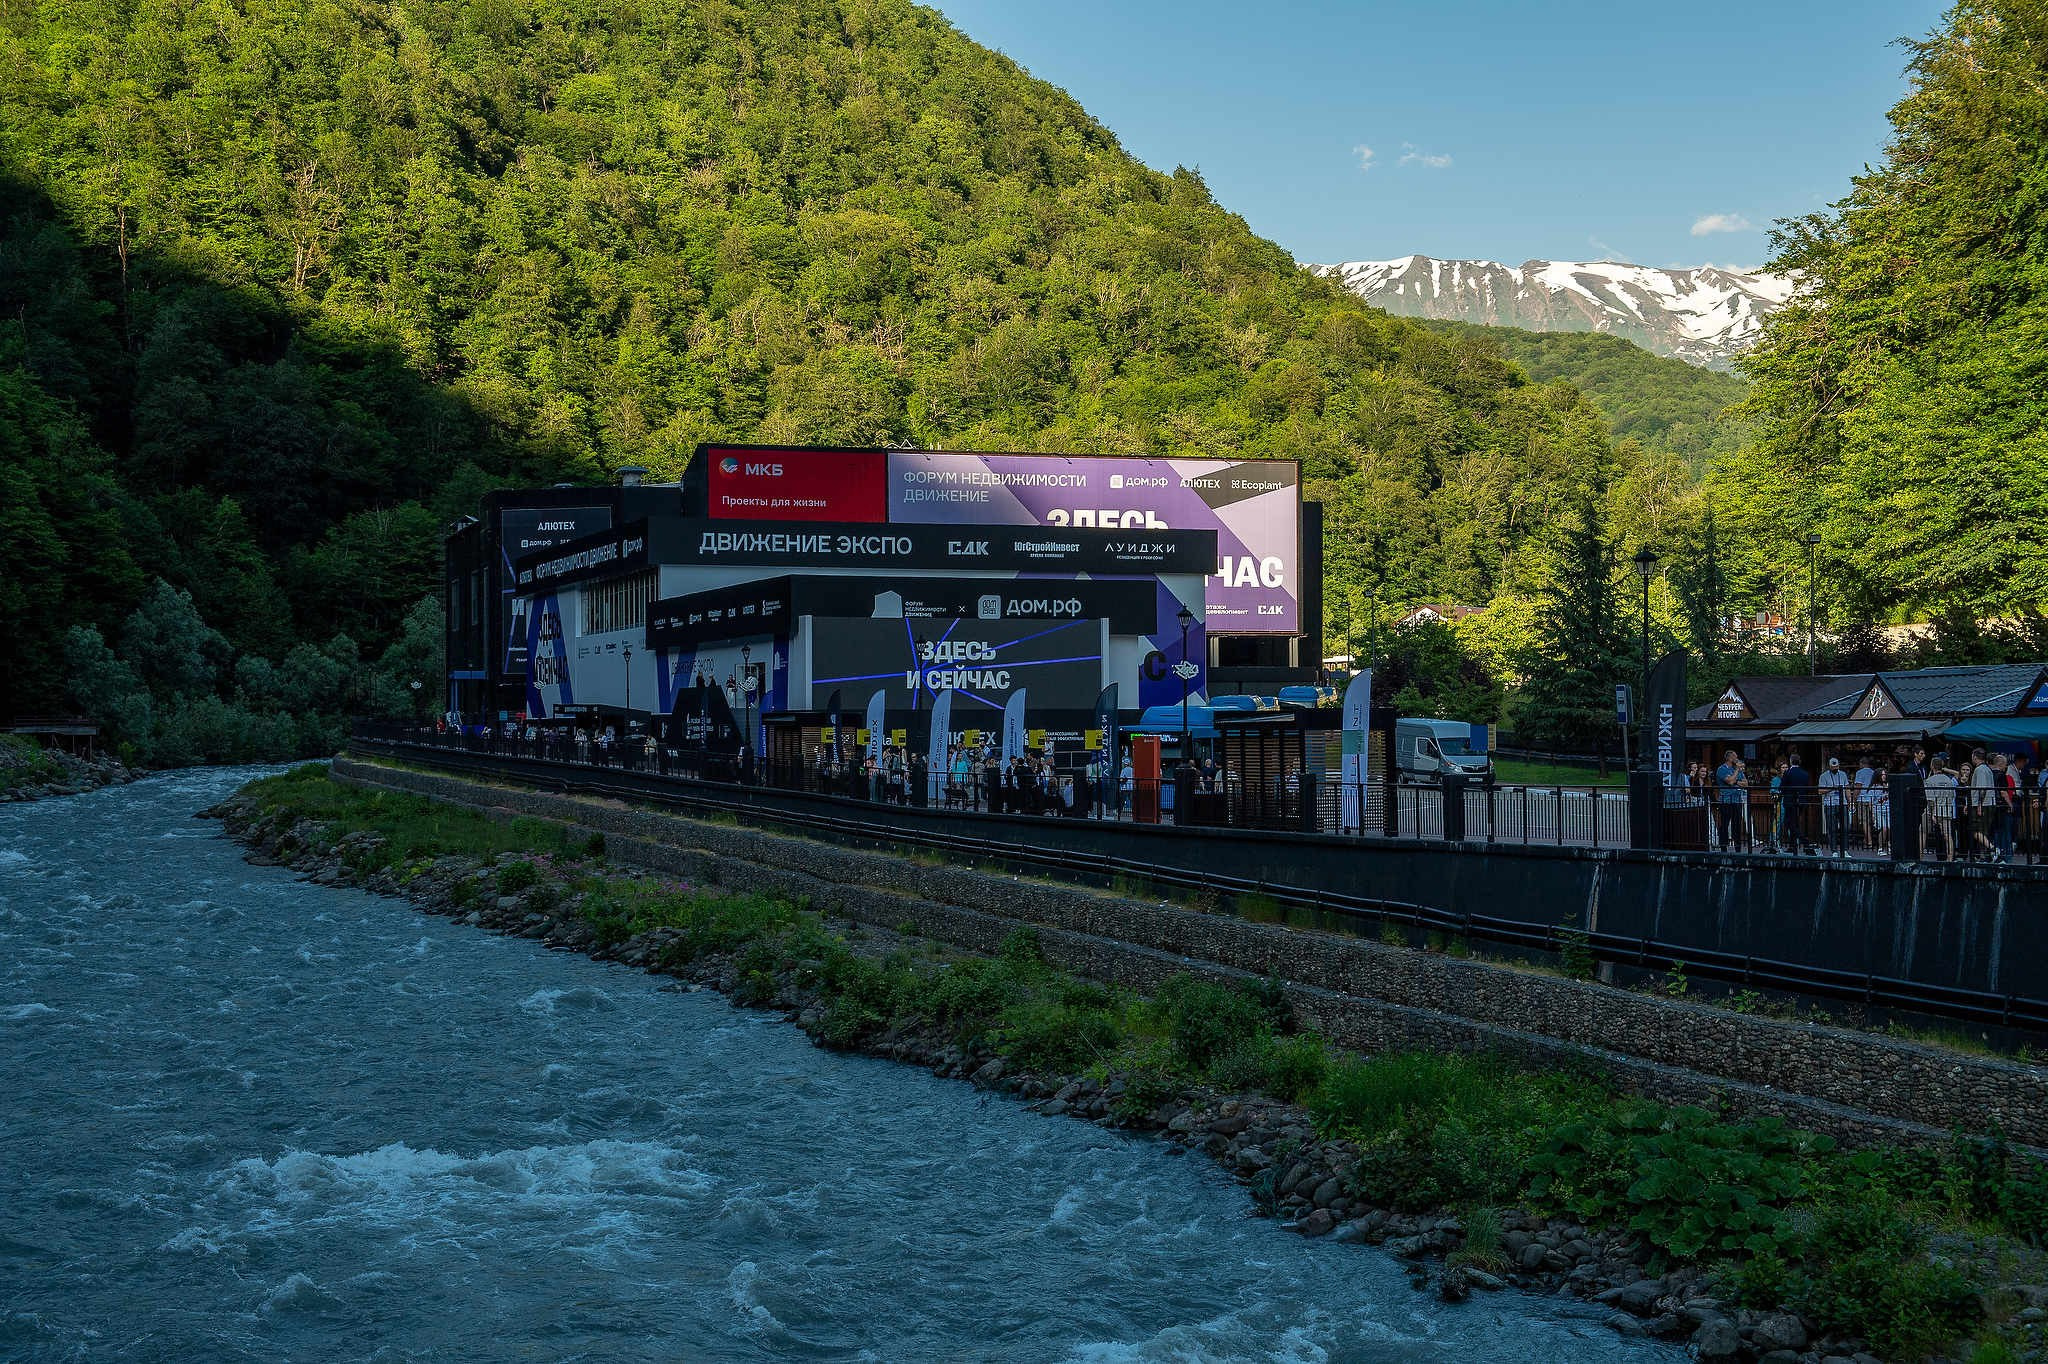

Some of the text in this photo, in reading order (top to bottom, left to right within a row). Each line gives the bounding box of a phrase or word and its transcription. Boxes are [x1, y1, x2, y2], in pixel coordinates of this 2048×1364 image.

[745, 463, 784, 477] МКБ
[903, 471, 1087, 487] ФОРУМ НЕДВИЖИМОСТИ
[1179, 479, 1221, 489] АЛЮТЕХ
[1241, 480, 1283, 492] Ecoplant
[722, 495, 827, 508] Проекты для жизни
[903, 488, 990, 503] ДВИЖЕНИЕ
[537, 521, 576, 531] АЛЮТЕХ
[699, 532, 913, 555] ДВИЖЕНИЕ ЭКСПО
[1205, 555, 1285, 589] ЧАС
[921, 640, 997, 664] ЗДЕСЬ
[906, 664, 1011, 690] И СЕЙЧАС
[1723, 711, 1741, 719] ГОРЫ
